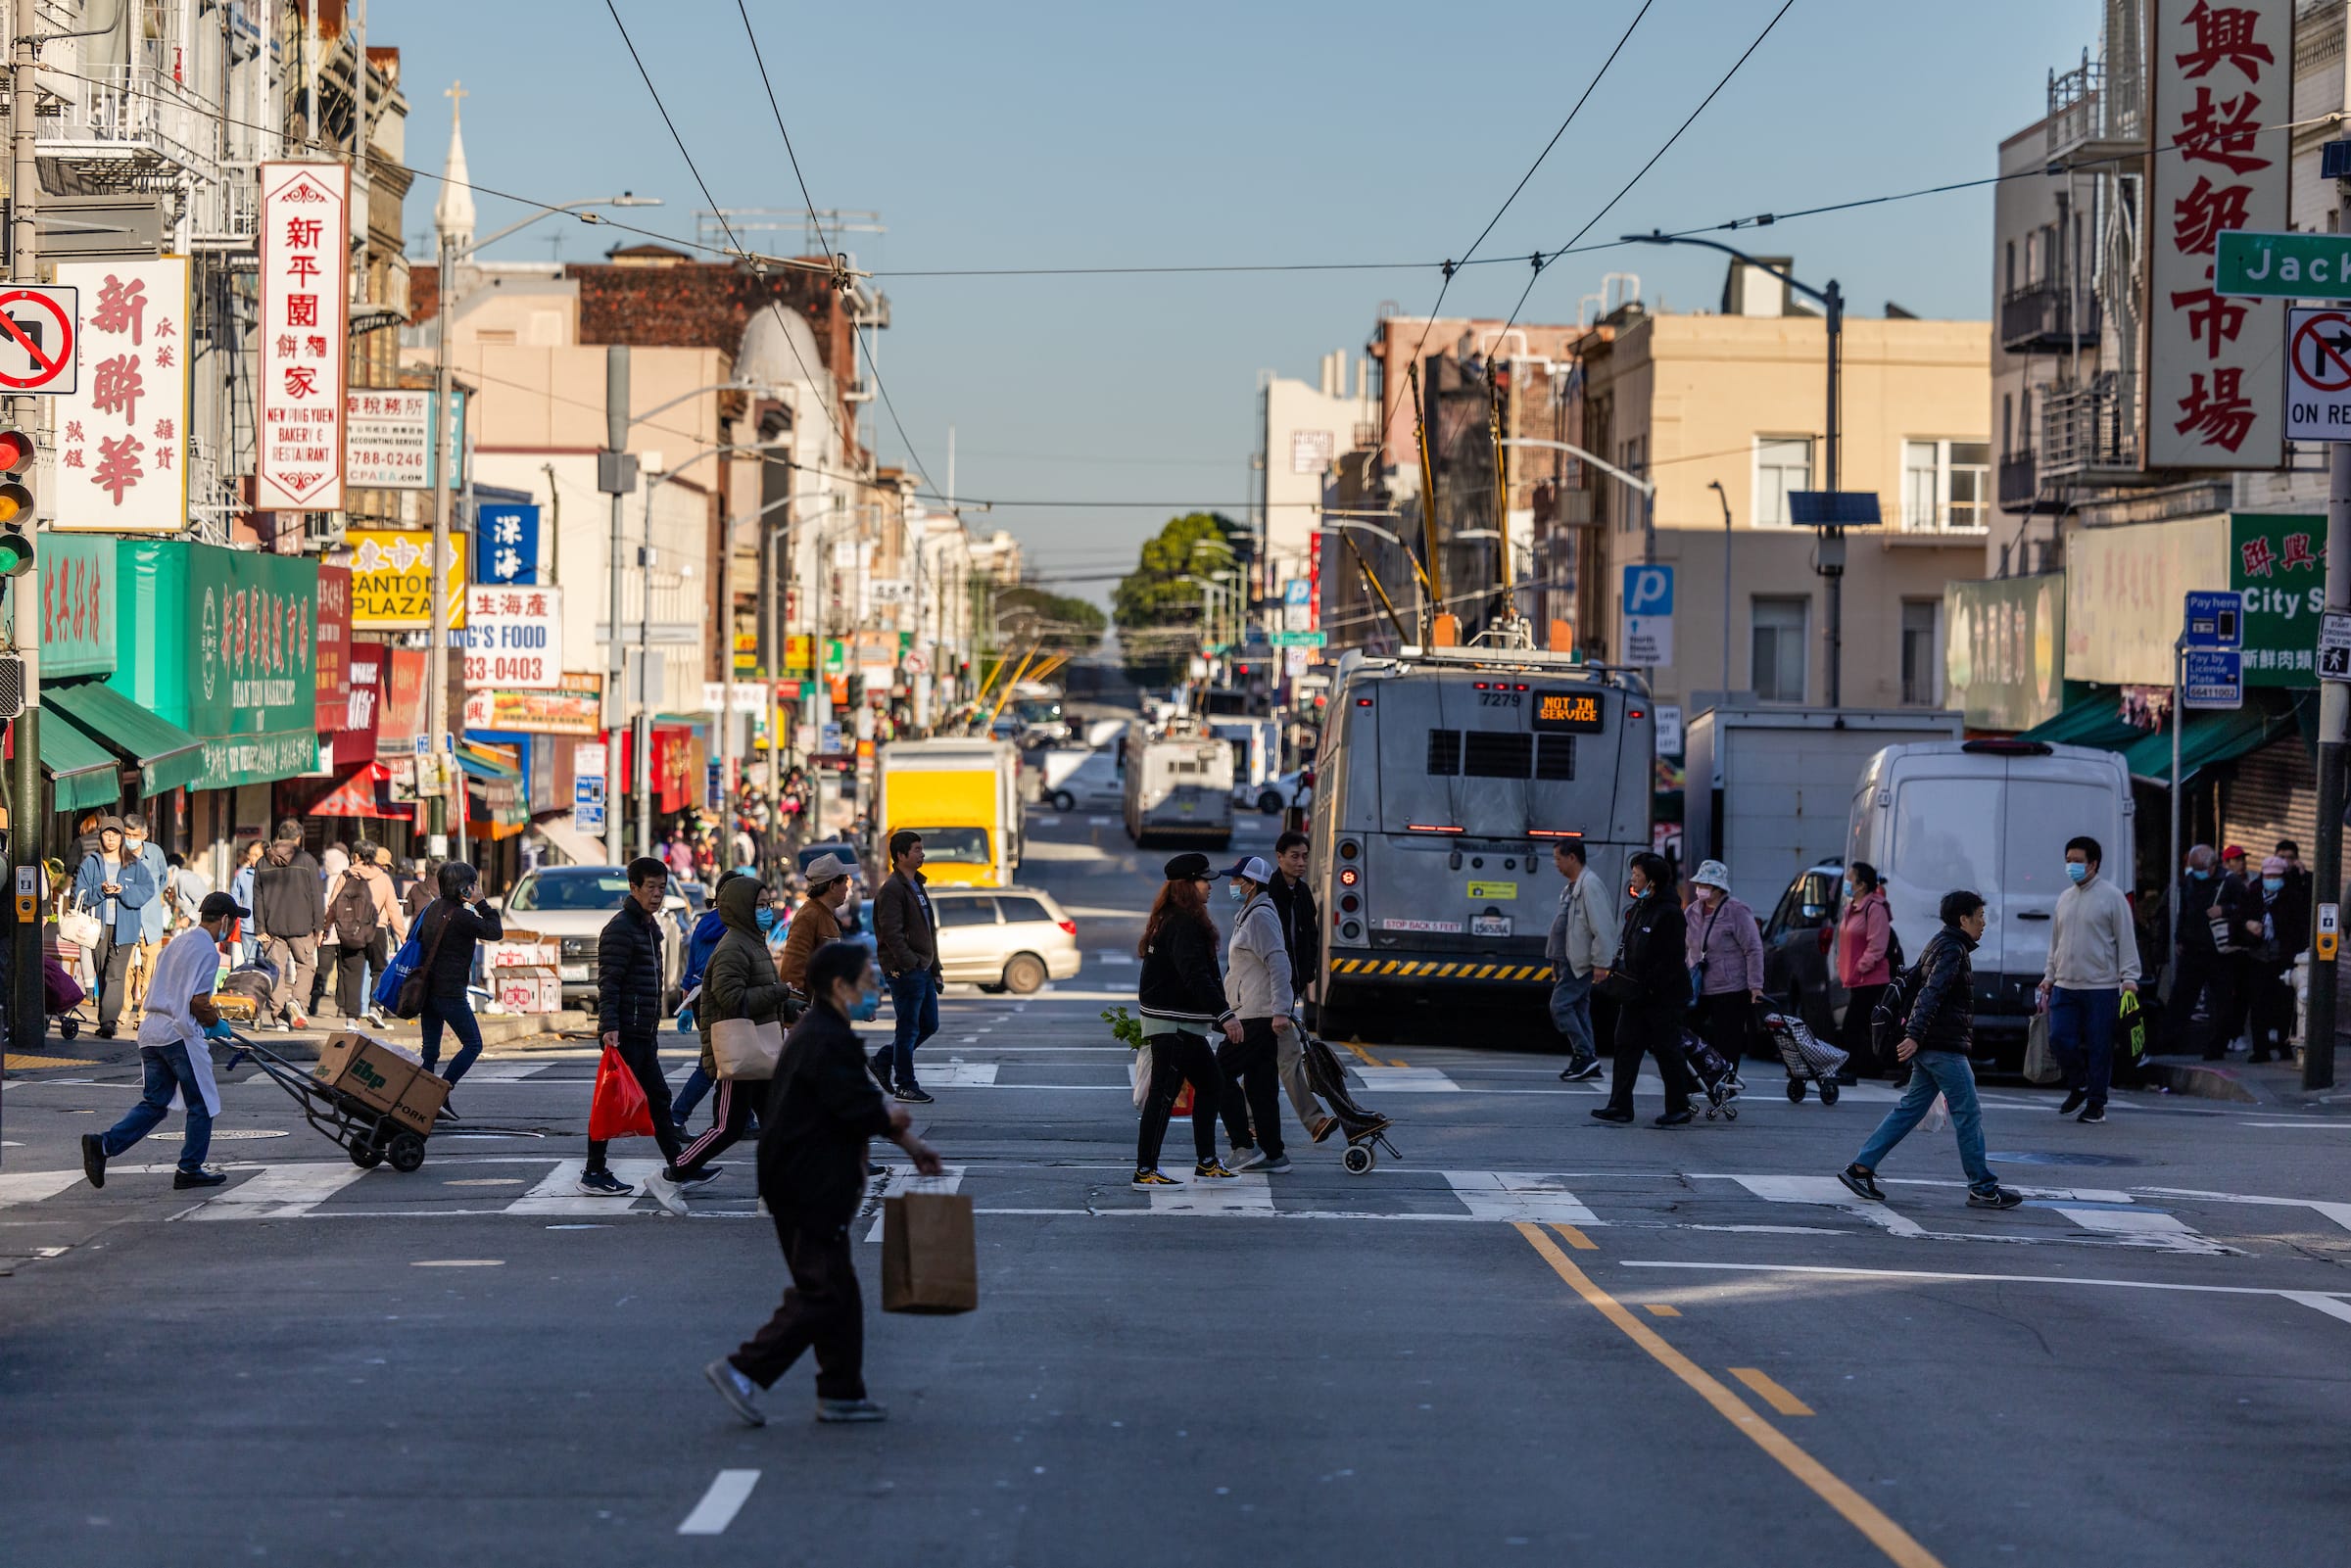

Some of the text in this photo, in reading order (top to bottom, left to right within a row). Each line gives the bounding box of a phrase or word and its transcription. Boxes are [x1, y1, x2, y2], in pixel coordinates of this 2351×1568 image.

[90, 274, 148, 506] 新聯華
[267, 407, 335, 423] NEW PING YUEN
[2292, 404, 2318, 423] ON
[279, 428, 312, 443] BAKERY
[272, 447, 329, 462] RESTAURANT
[351, 575, 433, 594] ANTO
[466, 594, 549, 617] 生海產
[2190, 596, 2238, 610] Pay here
[2242, 587, 2300, 619] City
[502, 625, 547, 648] FOOD
[2324, 629, 2351, 639] CROSSIN
[2326, 637, 2341, 645] ONLY
[2189, 653, 2225, 665] Pay by
[2189, 664, 2229, 674] License
[2189, 674, 2216, 684] Plate
[1481, 692, 1520, 706] 7279
[1544, 696, 1595, 711] NOT IN
[1540, 709, 1597, 721] SERVICE
[1386, 920, 1407, 928] STOP
[1409, 921, 1430, 929] BACK
[352, 1058, 387, 1090] ibp
[396, 1101, 427, 1123] PORK
